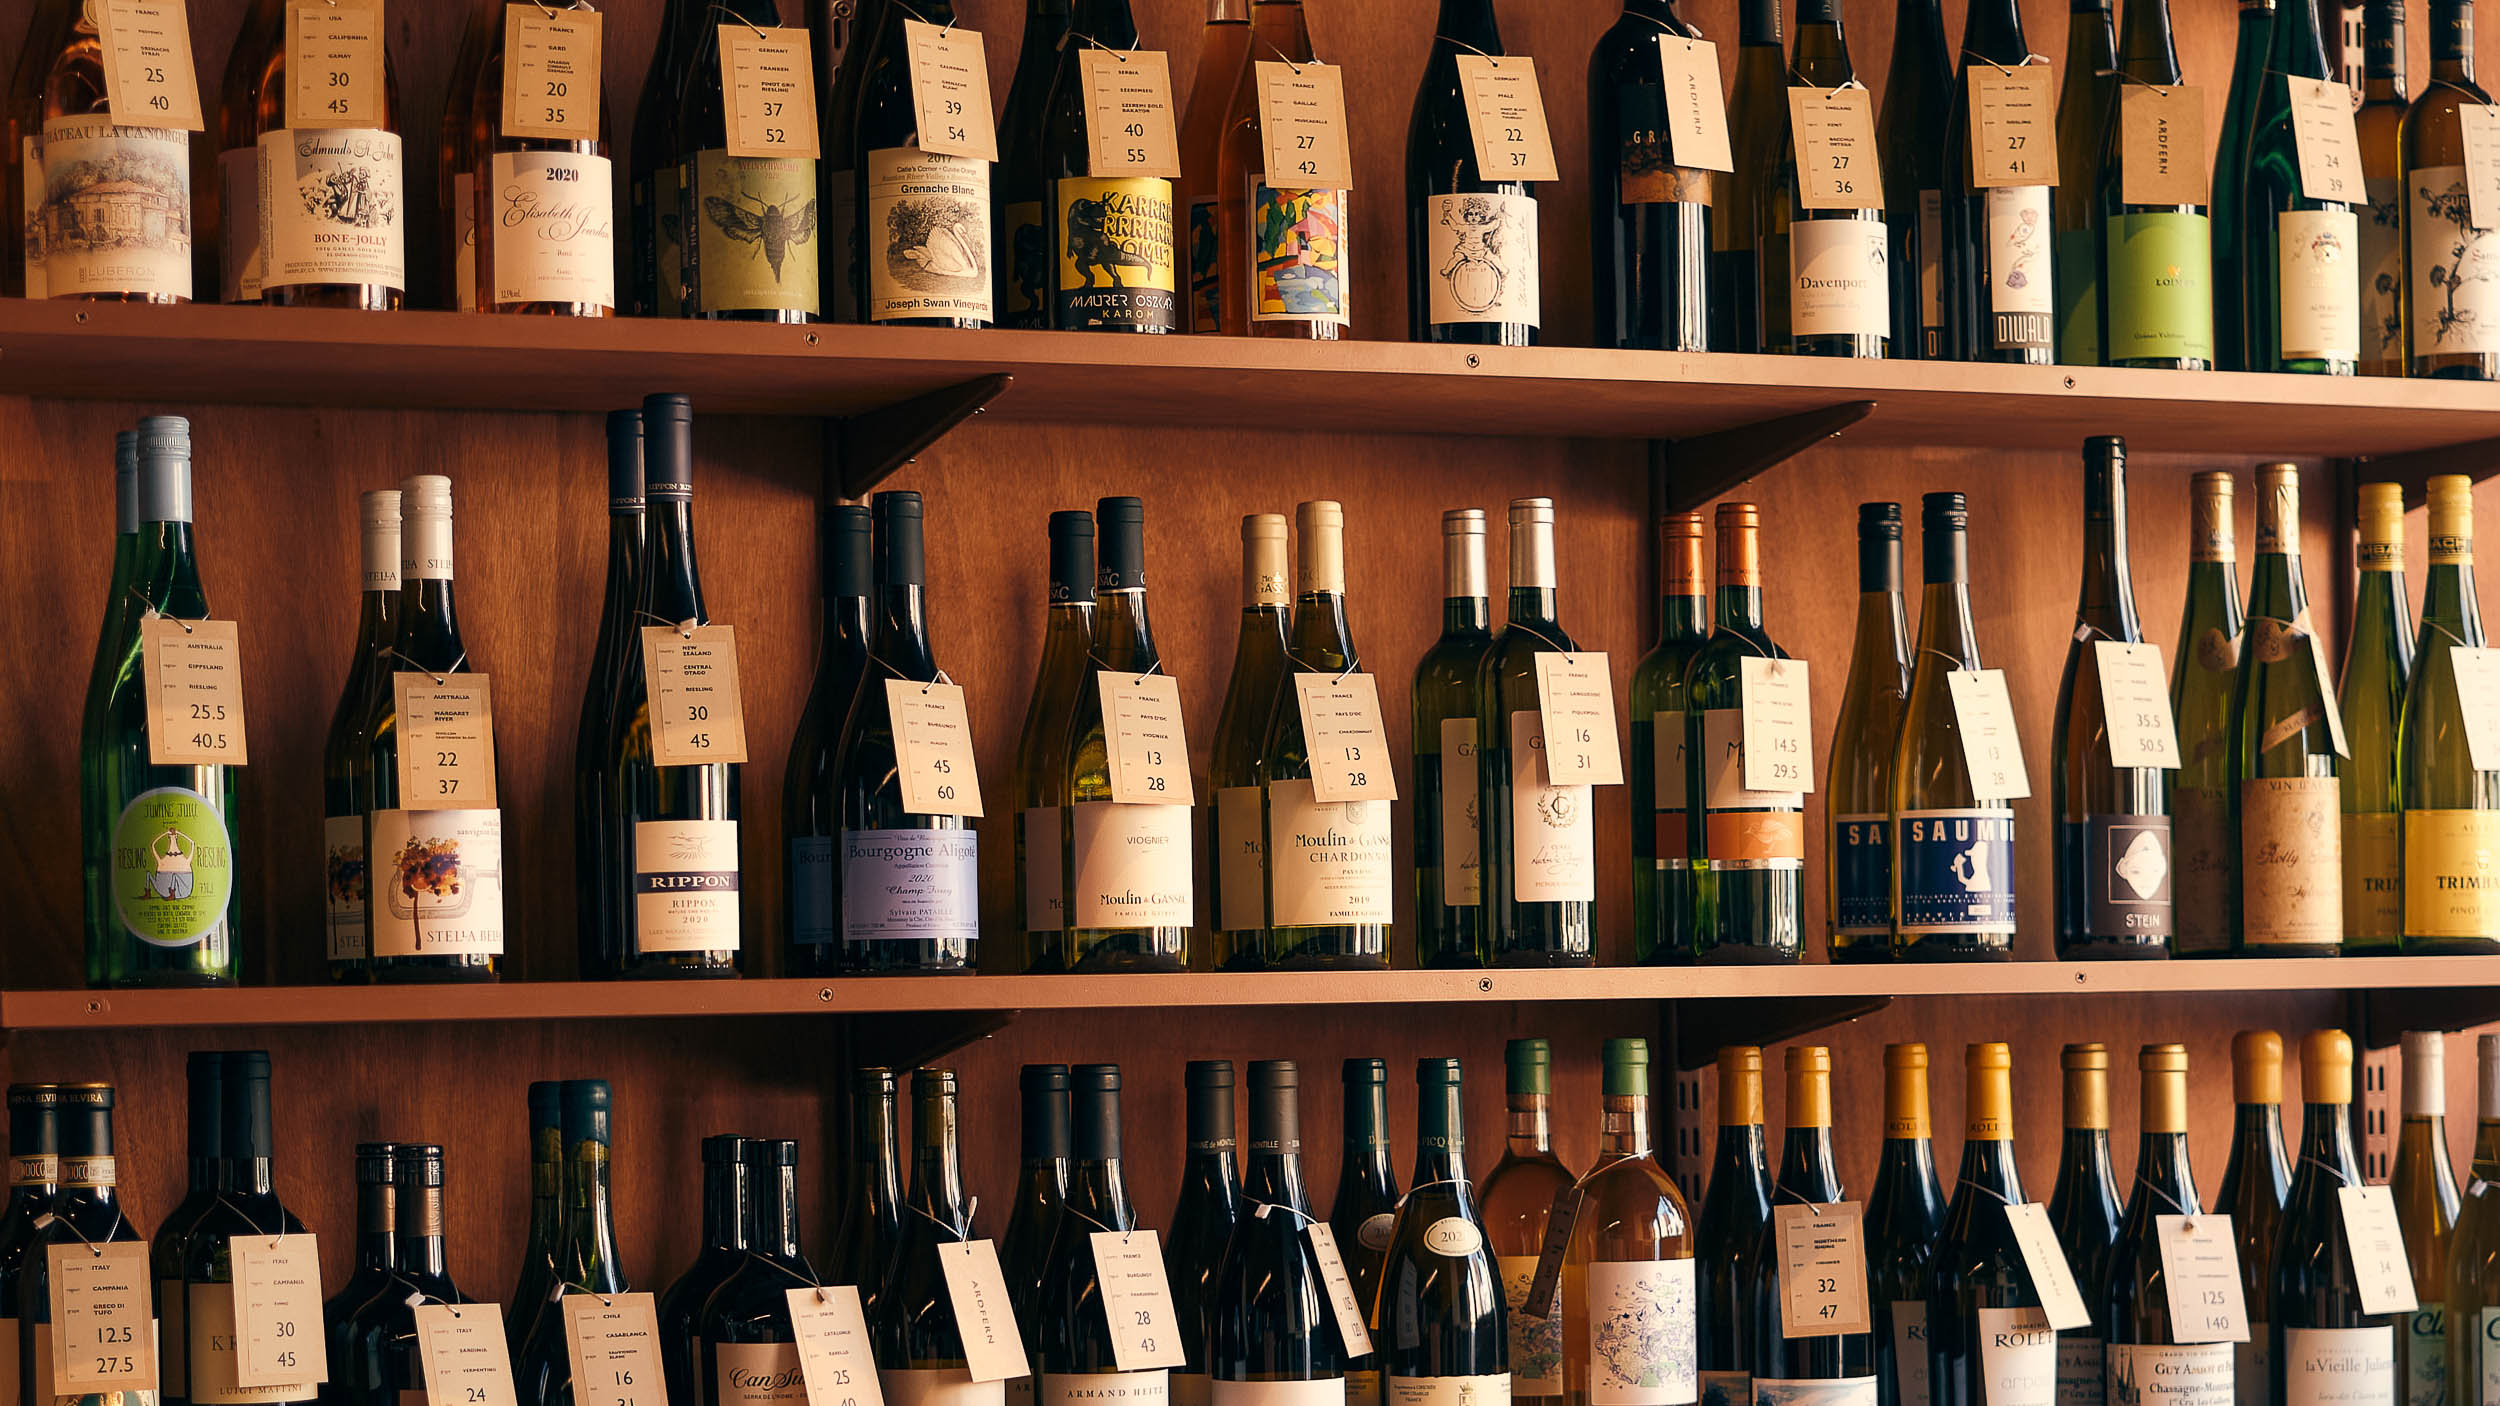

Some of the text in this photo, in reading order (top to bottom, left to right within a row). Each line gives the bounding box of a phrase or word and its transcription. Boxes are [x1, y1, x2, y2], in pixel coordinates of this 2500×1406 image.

[144, 67, 165, 84] 25
[328, 72, 349, 88] 30
[546, 82, 568, 98] 20
[149, 95, 170, 111] 40
[327, 99, 349, 114] 45
[764, 102, 783, 117] 37
[945, 100, 962, 115] 39
[1687, 73, 1704, 135] ARDFERN
[545, 108, 566, 123] 35
[766, 128, 786, 144] 52
[948, 127, 966, 142] 54
[1124, 123, 1144, 138] 40
[1505, 128, 1524, 142] 22
[296, 137, 352, 158] Edmunds
[1296, 135, 1315, 150] 27
[2008, 136, 2026, 150] 27
[2158, 118, 2169, 175] ARDFERN
[927, 153, 953, 163] 2017
[1127, 148, 1146, 163] 55
[1511, 152, 1528, 167] 37
[1832, 156, 1850, 170] 27
[546, 167, 579, 182] 2020
[1298, 160, 1317, 175] 42
[2008, 161, 2025, 173] 41
[901, 183, 975, 196] Grenache Blanc
[1834, 180, 1853, 194] 36
[313, 233, 387, 247] BONE-JOLLY
[885, 298, 989, 312] Joseph Swan Vineyards
[1069, 294, 1127, 309] MAURER
[1102, 309, 1154, 320] KAROM
[1998, 315, 2050, 344] DIWALD
[187, 643, 224, 651] AUSTRALIA
[191, 704, 226, 721] 25.5
[688, 705, 708, 721] 30
[2136, 714, 2161, 728] 35.5
[192, 733, 227, 749] 40.5
[690, 733, 710, 749] 45
[1576, 728, 1591, 743] 16
[1774, 737, 1798, 753] 14.5
[2139, 738, 2165, 753] 50.5
[437, 752, 459, 767] 22
[1146, 751, 1162, 766] 13
[1345, 747, 1361, 761] 13
[933, 759, 951, 774] 45
[1577, 755, 1591, 769] 31
[1347, 772, 1367, 786] 28
[1774, 764, 1799, 779] 29.5
[439, 779, 459, 794] 37
[1148, 777, 1166, 791] 28
[937, 785, 955, 800] 60
[1295, 827, 1347, 848] Moulin
[848, 843, 976, 862] Bourgogne Aligoté
[650, 875, 730, 889] RIPPON
[908, 873, 934, 883] 2020
[886, 885, 924, 897] Champ
[1100, 889, 1142, 906] Moulin
[672, 899, 717, 909] RIPPON
[2125, 913, 2161, 929] STEIN
[1817, 1279, 1836, 1293] 32
[2202, 1290, 2225, 1305] 125
[971, 1279, 995, 1345] ARDFERN
[1134, 1310, 1151, 1325] 28
[1819, 1304, 1838, 1319] 47
[276, 1321, 295, 1337] 30
[2205, 1316, 2229, 1330] 140
[98, 1327, 132, 1344] 12.5
[1994, 1331, 2054, 1348] ROLET
[1140, 1338, 1156, 1353] 43
[96, 1356, 134, 1374] 27.5
[277, 1351, 296, 1367] 45
[615, 1370, 634, 1386] 16
[729, 1367, 771, 1389] Can
[833, 1369, 850, 1385] 25
[466, 1387, 487, 1402] 24
[1067, 1387, 1127, 1398] ARMAND
